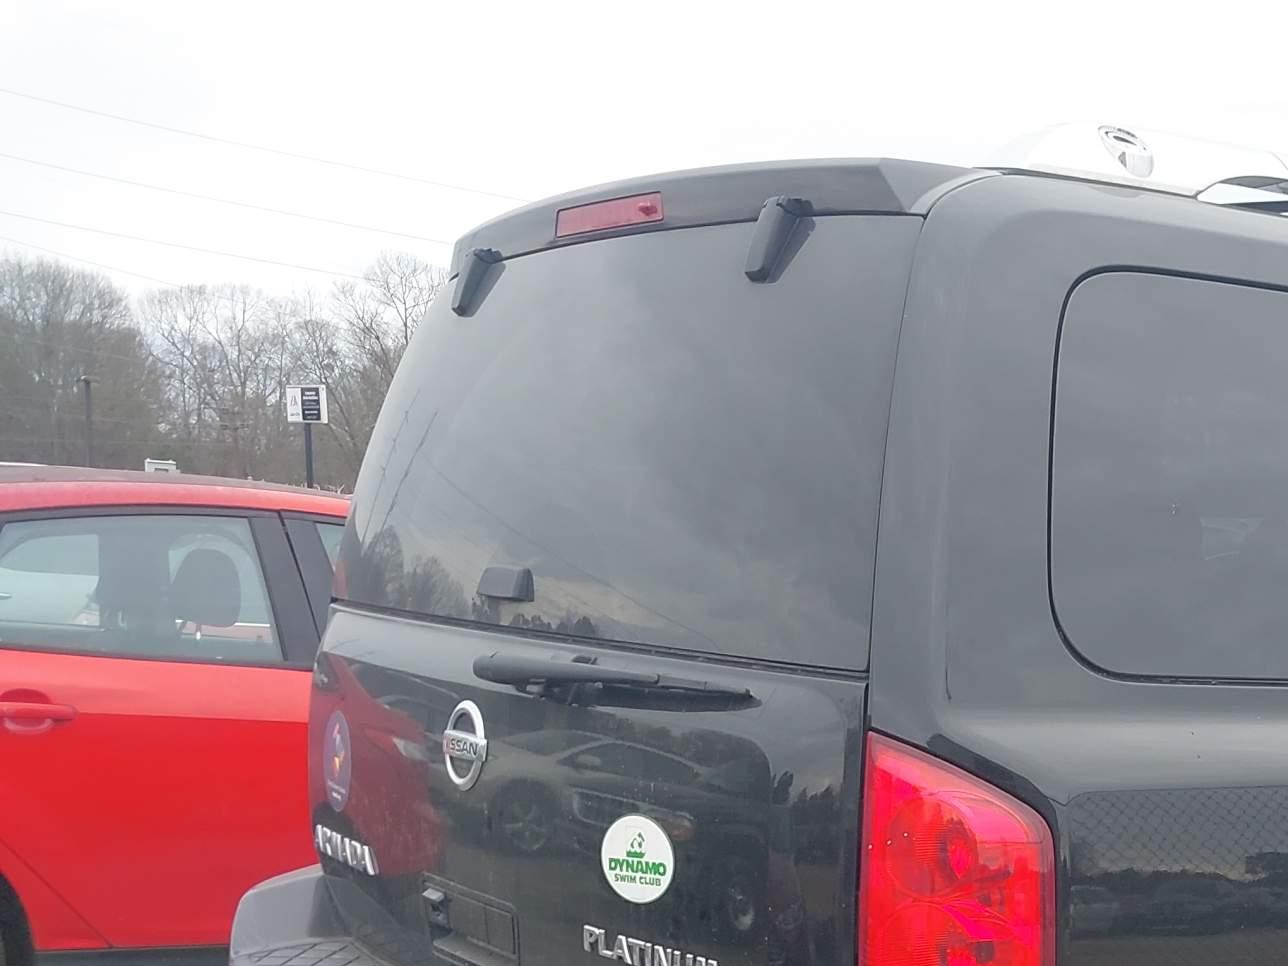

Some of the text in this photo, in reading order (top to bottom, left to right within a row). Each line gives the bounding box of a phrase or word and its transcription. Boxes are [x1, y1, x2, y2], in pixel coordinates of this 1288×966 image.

[444, 738, 478, 756] ISSAN
[608, 857, 667, 876] DYNAMO
[614, 873, 662, 887] SWIM CLUB
